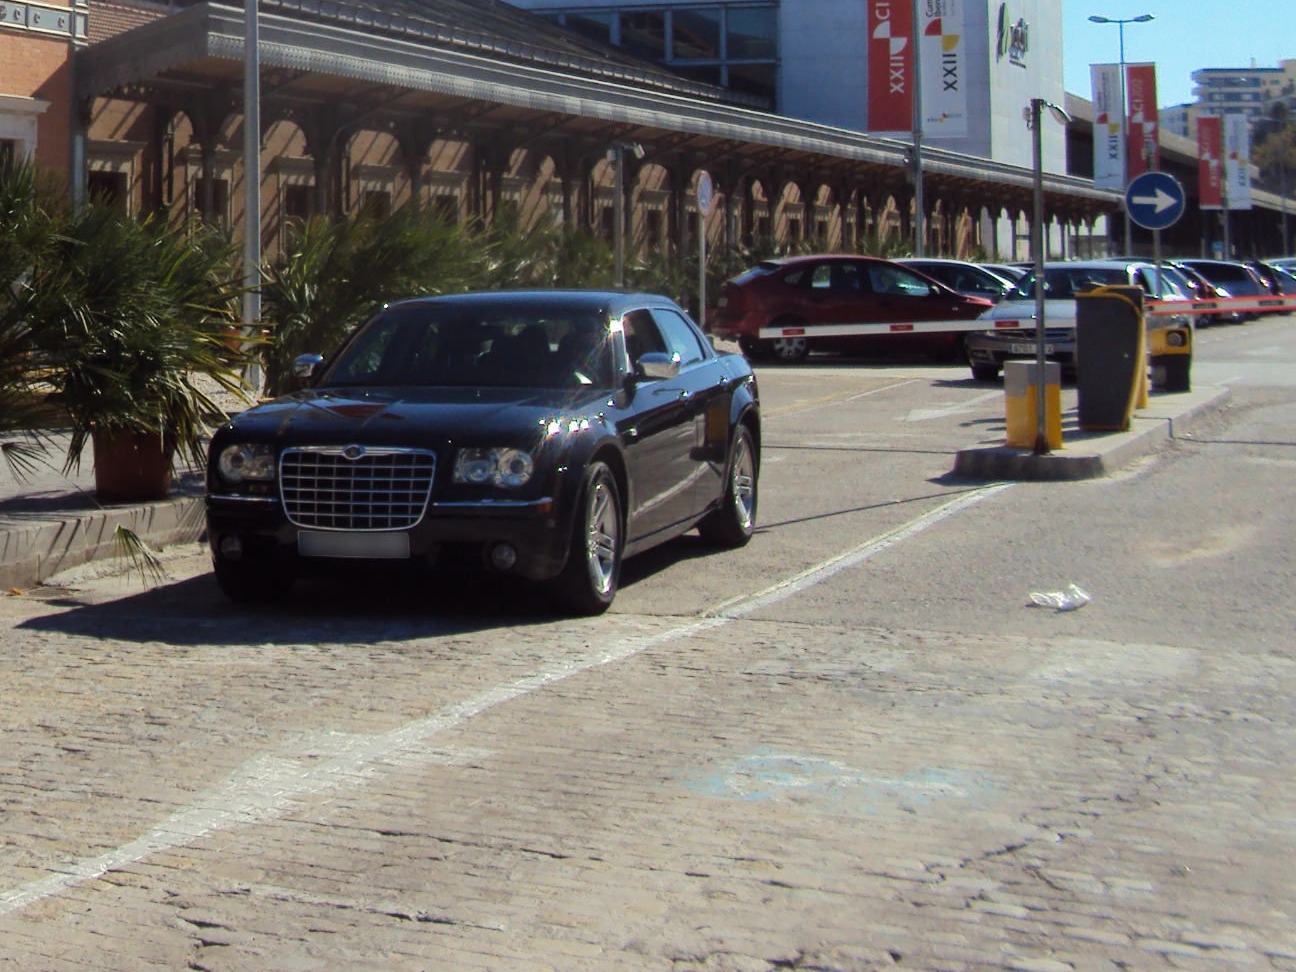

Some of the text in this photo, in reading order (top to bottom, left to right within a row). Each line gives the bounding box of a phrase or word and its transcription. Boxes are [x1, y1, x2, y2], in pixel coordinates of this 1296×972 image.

[875, 2, 890, 20] CI
[889, 55, 905, 94] XXII
[942, 53, 958, 92] XXII
[1108, 135, 1119, 160] XXII
